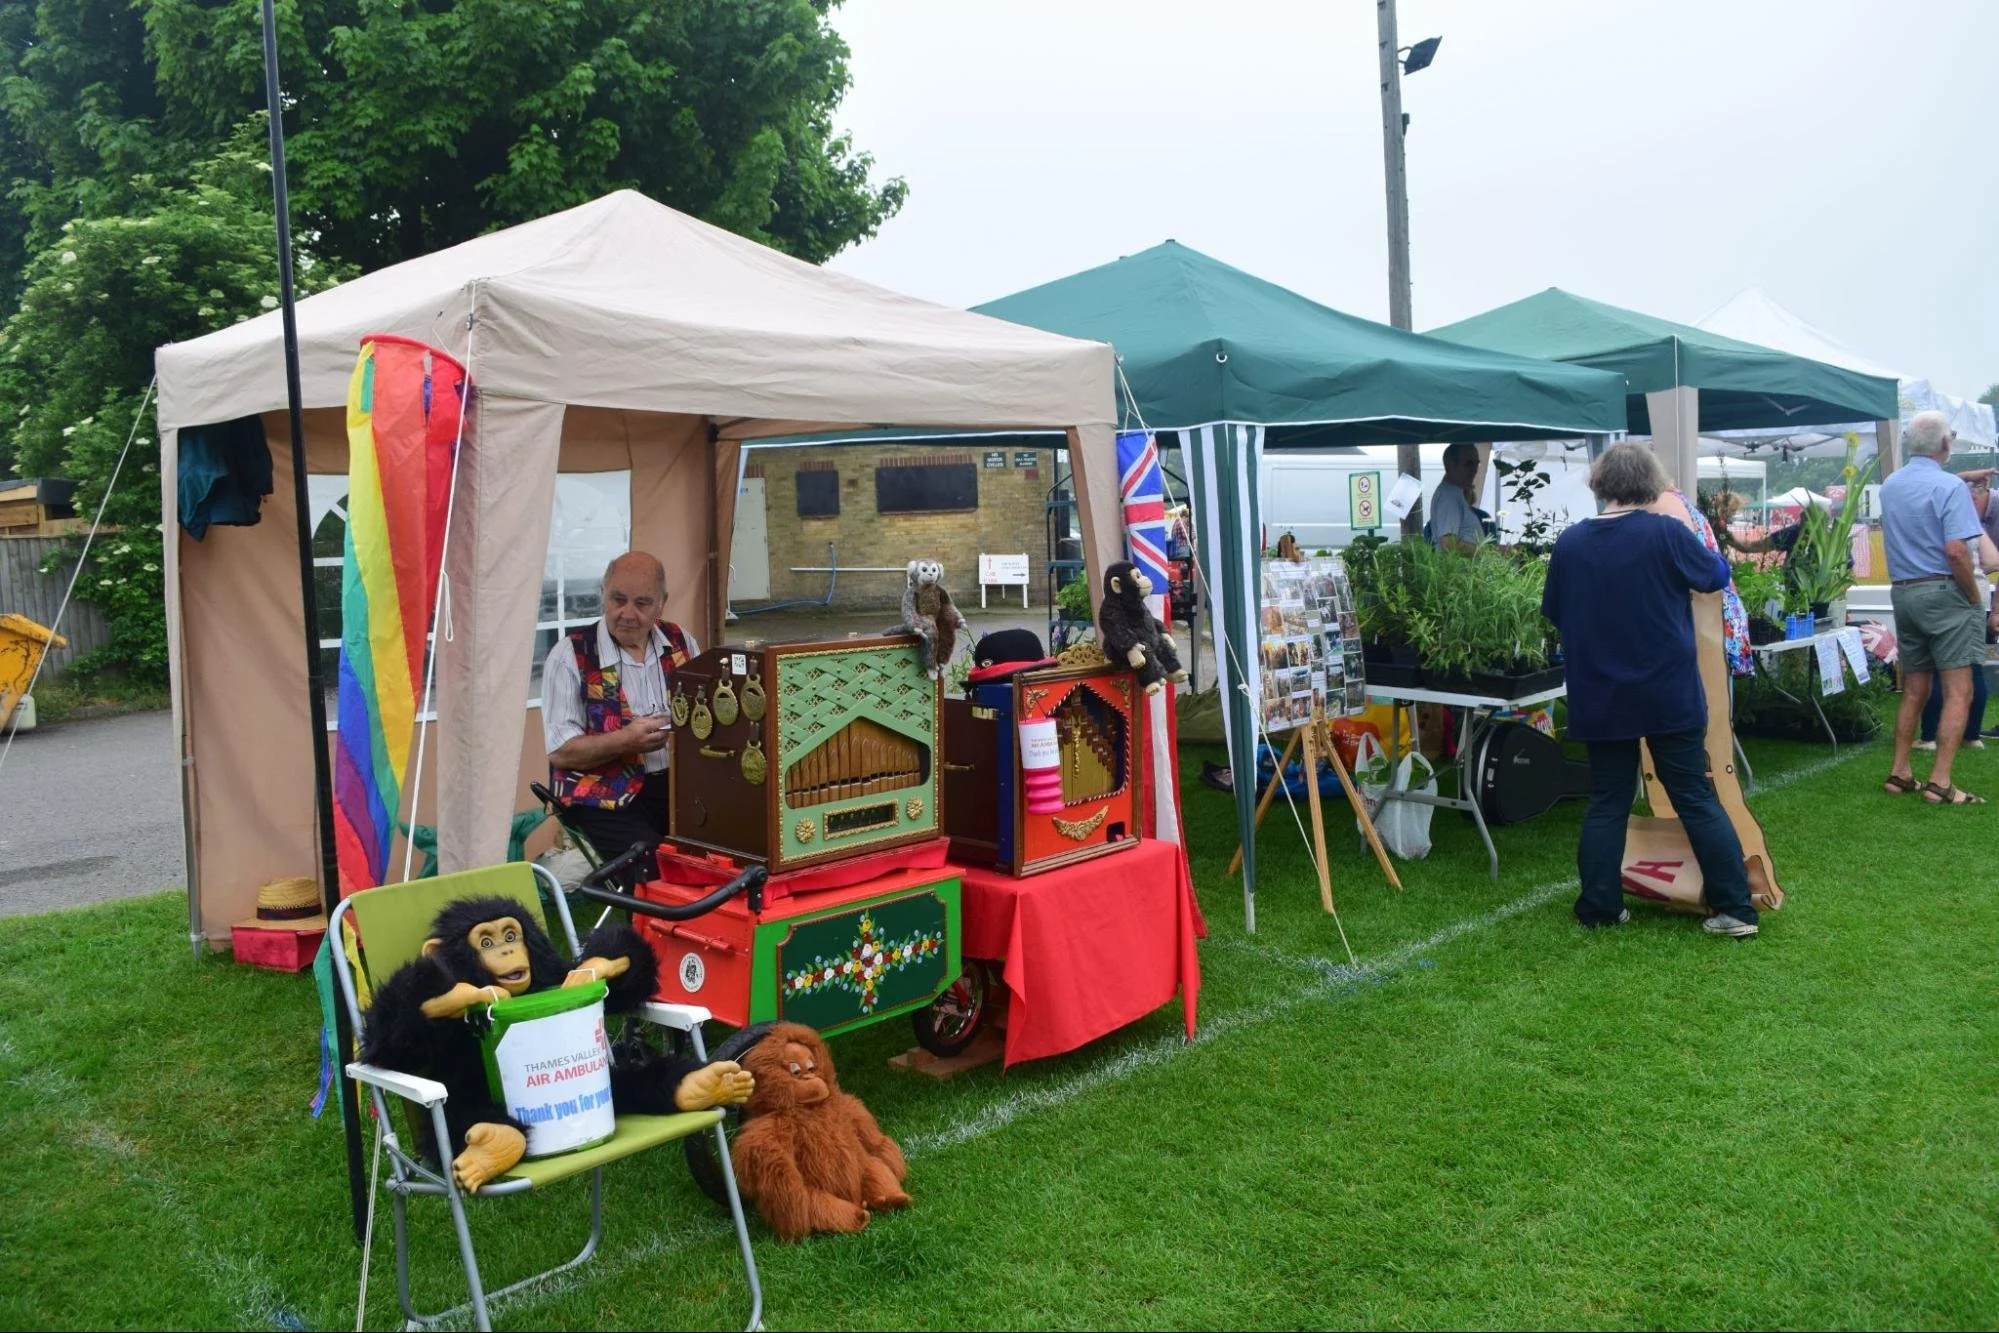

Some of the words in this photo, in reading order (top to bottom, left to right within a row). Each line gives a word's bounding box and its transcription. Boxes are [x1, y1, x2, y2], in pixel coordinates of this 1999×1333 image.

[524, 1056, 570, 1073] THAMES
[526, 1073, 552, 1088] AIR
[515, 1102, 554, 1125] Thank
[555, 1099, 578, 1121] you
[579, 1094, 595, 1112] for
[595, 1087, 611, 1109] you
